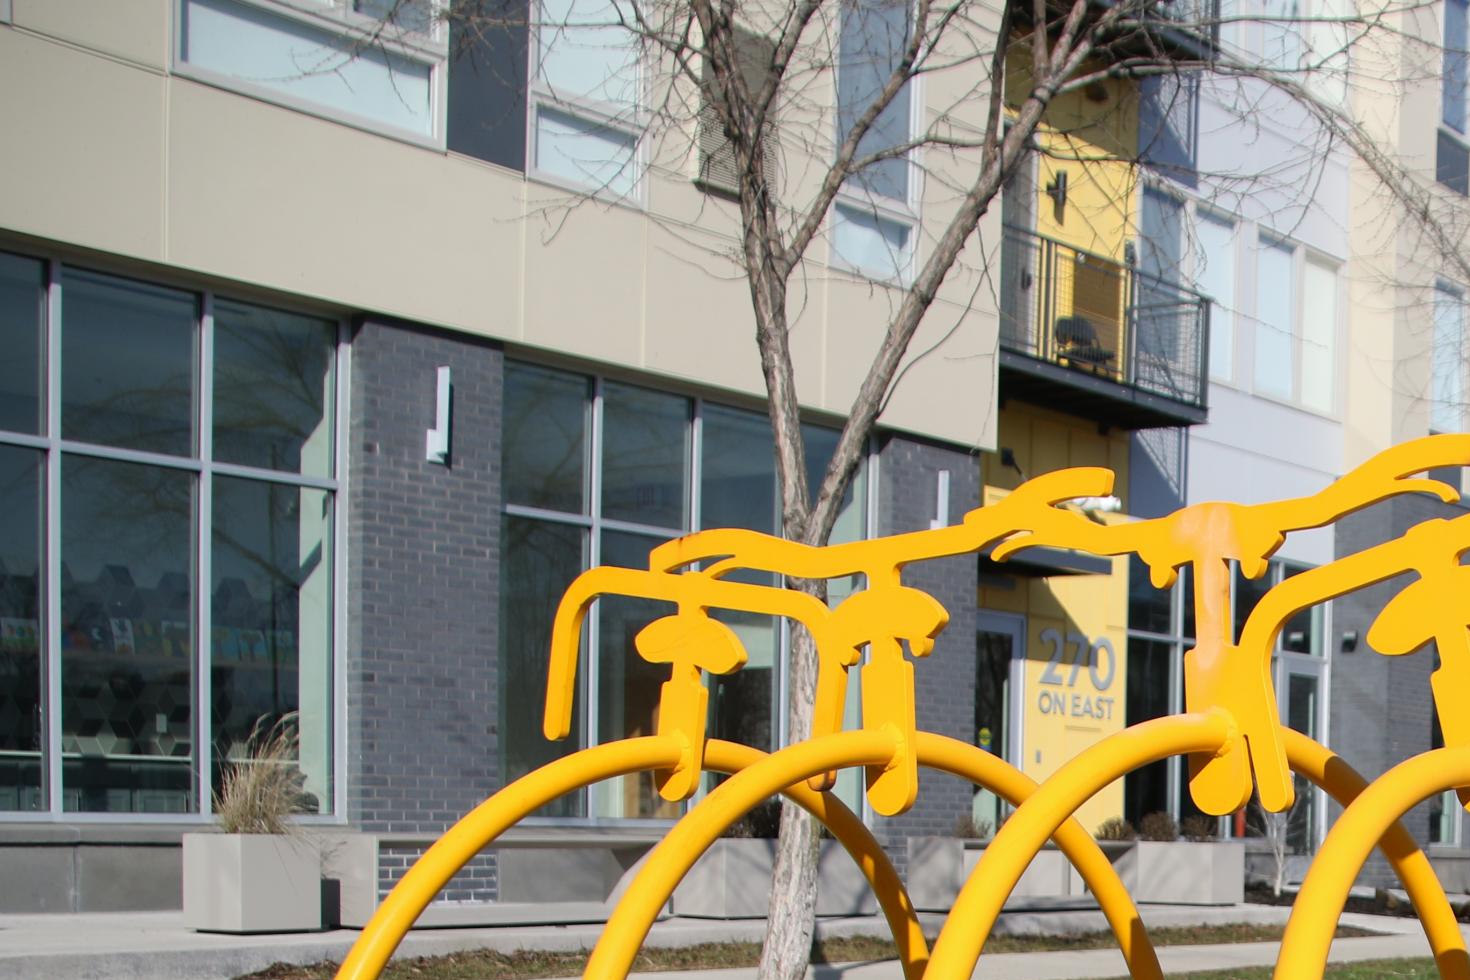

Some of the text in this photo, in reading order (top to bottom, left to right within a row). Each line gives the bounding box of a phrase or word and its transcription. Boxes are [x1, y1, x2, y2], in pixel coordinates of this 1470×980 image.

[1039, 628, 1116, 691] 270
[1038, 691, 1114, 720] ON EAST
